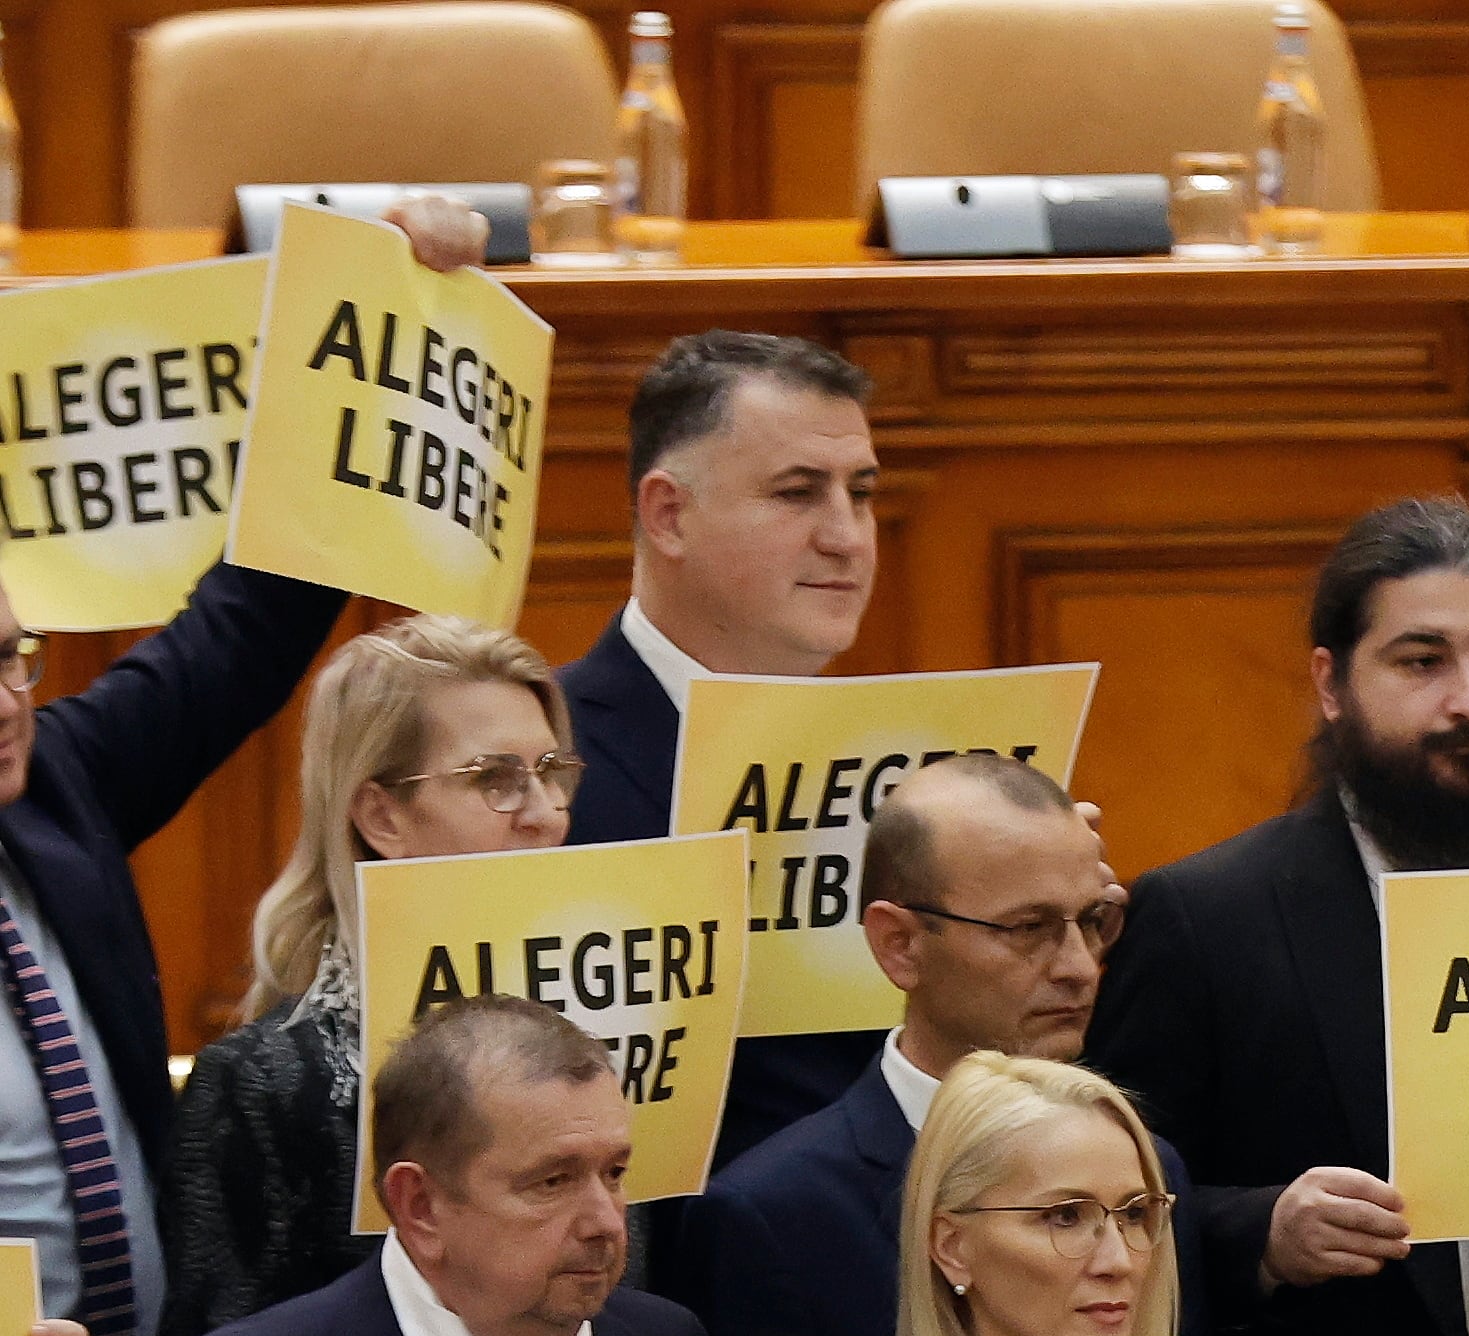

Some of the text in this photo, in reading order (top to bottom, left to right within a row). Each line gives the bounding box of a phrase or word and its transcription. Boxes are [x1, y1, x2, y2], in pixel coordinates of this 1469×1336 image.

[0, 337, 262, 444] LEGER
[307, 300, 533, 472] ALEGERI
[332, 407, 511, 561] LIBERE
